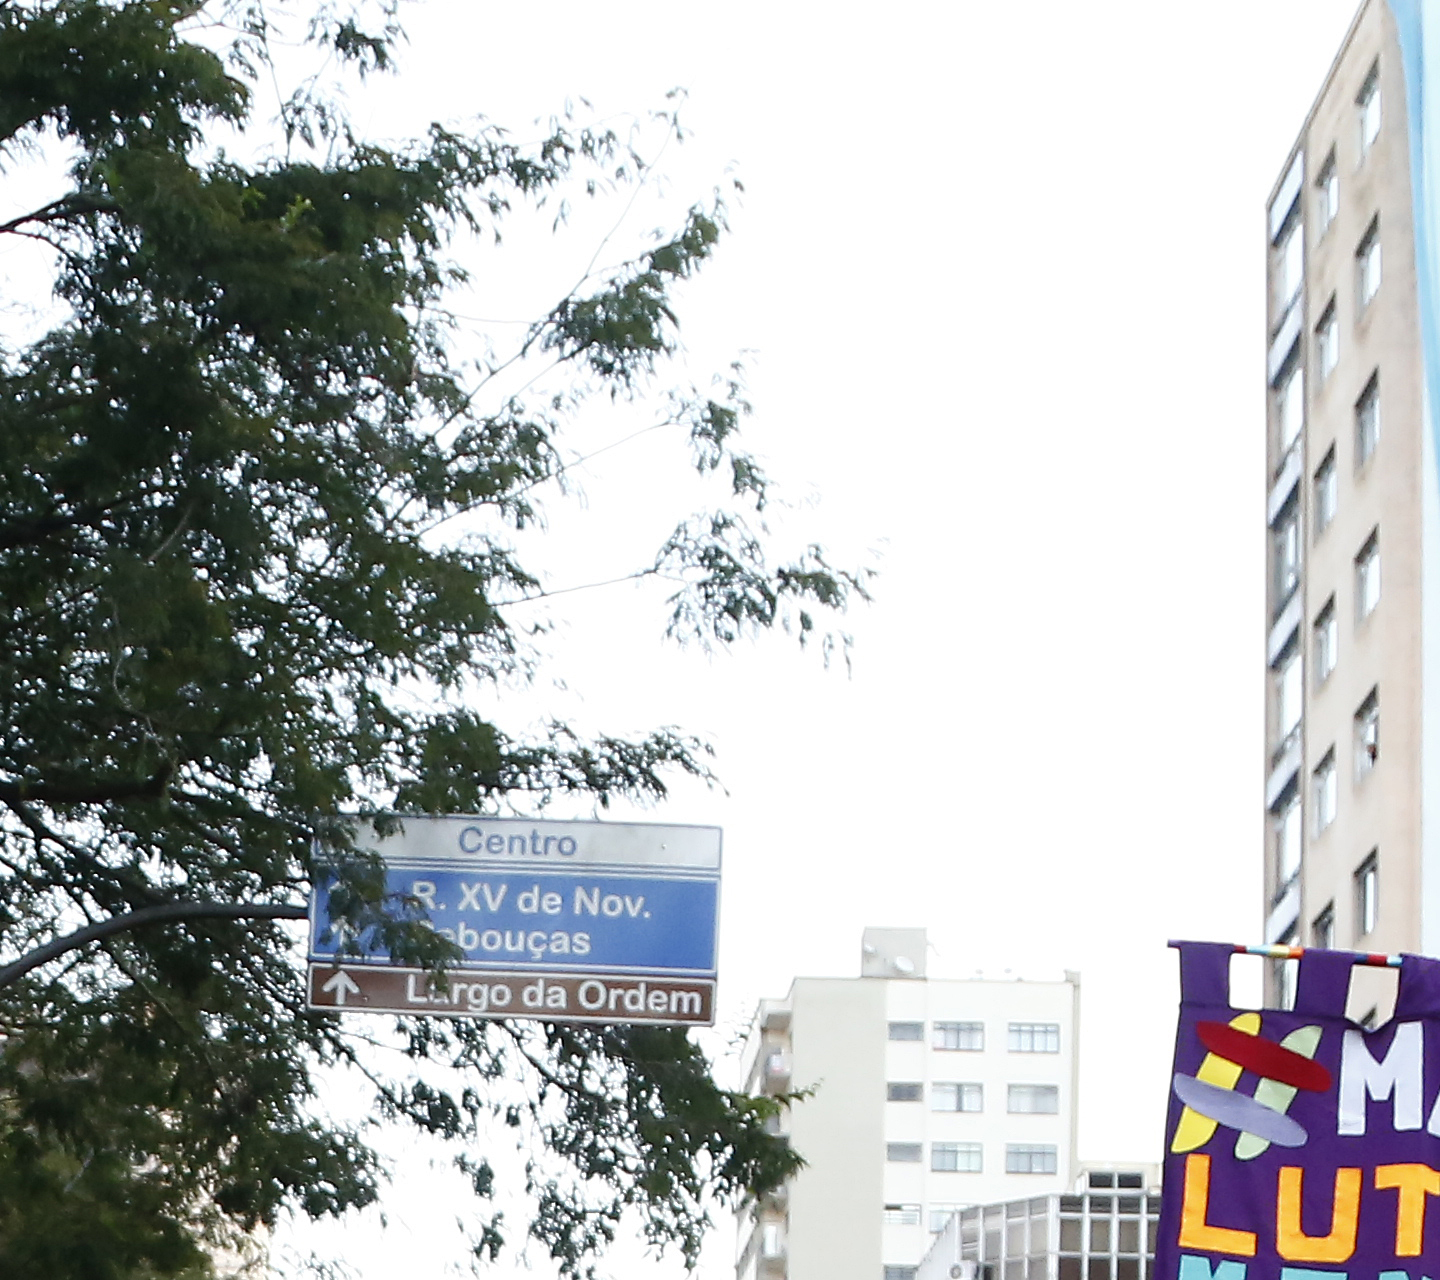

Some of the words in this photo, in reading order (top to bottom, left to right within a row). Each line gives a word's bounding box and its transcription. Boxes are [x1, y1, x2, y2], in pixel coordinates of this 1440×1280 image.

[459, 826, 579, 857] Centro
[412, 881, 447, 911] R.
[458, 882, 508, 912] XV
[517, 884, 563, 915] de
[574, 886, 651, 919] Nov.
[421, 921, 591, 960] ebouças
[522, 978, 567, 1009] da
[578, 980, 702, 1016] Ordem
